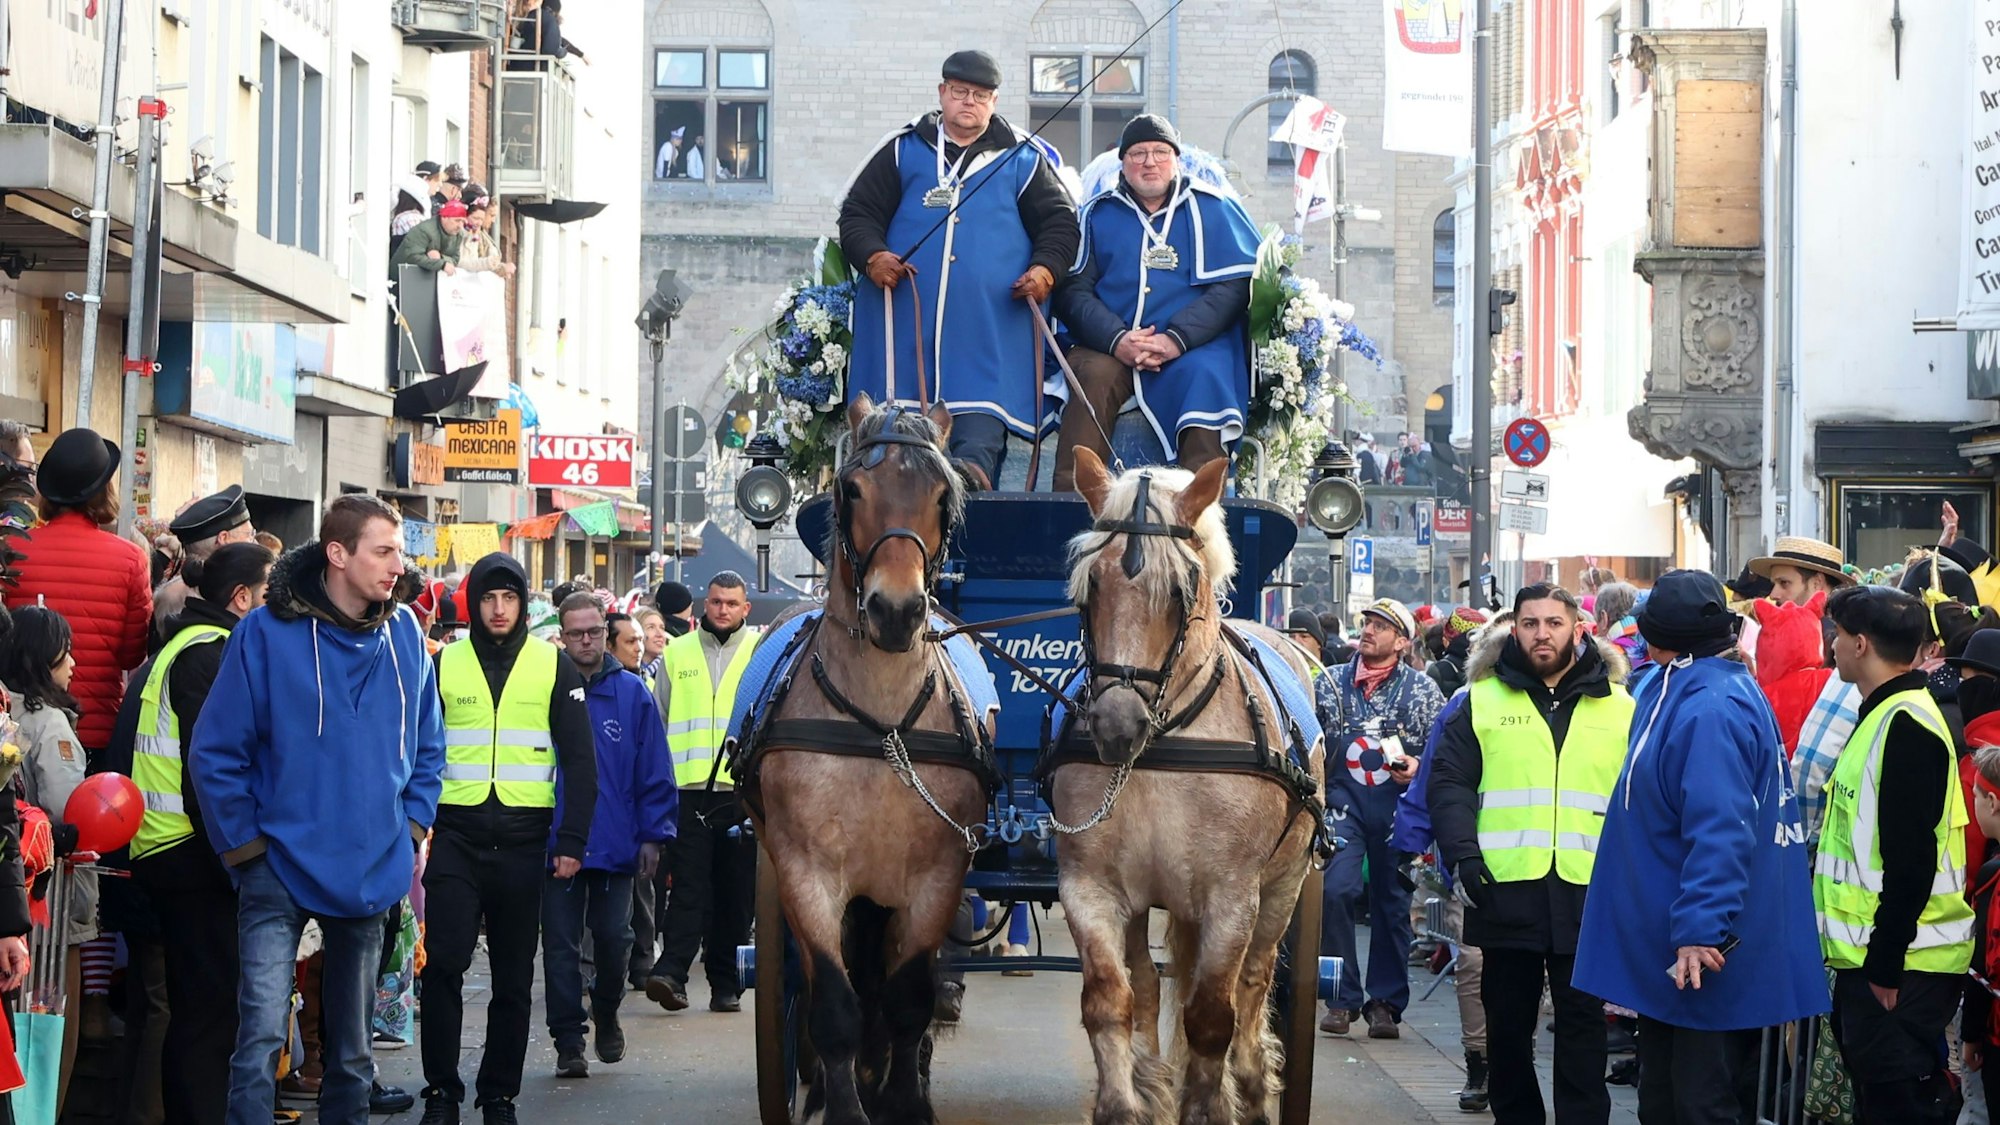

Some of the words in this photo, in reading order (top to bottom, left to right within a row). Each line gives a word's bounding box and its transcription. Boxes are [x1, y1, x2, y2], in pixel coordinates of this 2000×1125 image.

[1980, 89, 2000, 112] Ar
[1974, 135, 1996, 152] Ital.
[459, 419, 507, 435] CASITA
[448, 438, 516, 455] MEXICANA
[529, 436, 631, 462] KIOSK
[461, 469, 484, 480] Gaffel
[485, 469, 512, 481] Kölsch
[562, 462, 599, 485] 46
[1419, 507, 1428, 541] P
[1354, 542, 1367, 570] P
[677, 669, 699, 680] 2920
[456, 696, 477, 705] 0662
[1499, 715, 1531, 726] 2917
